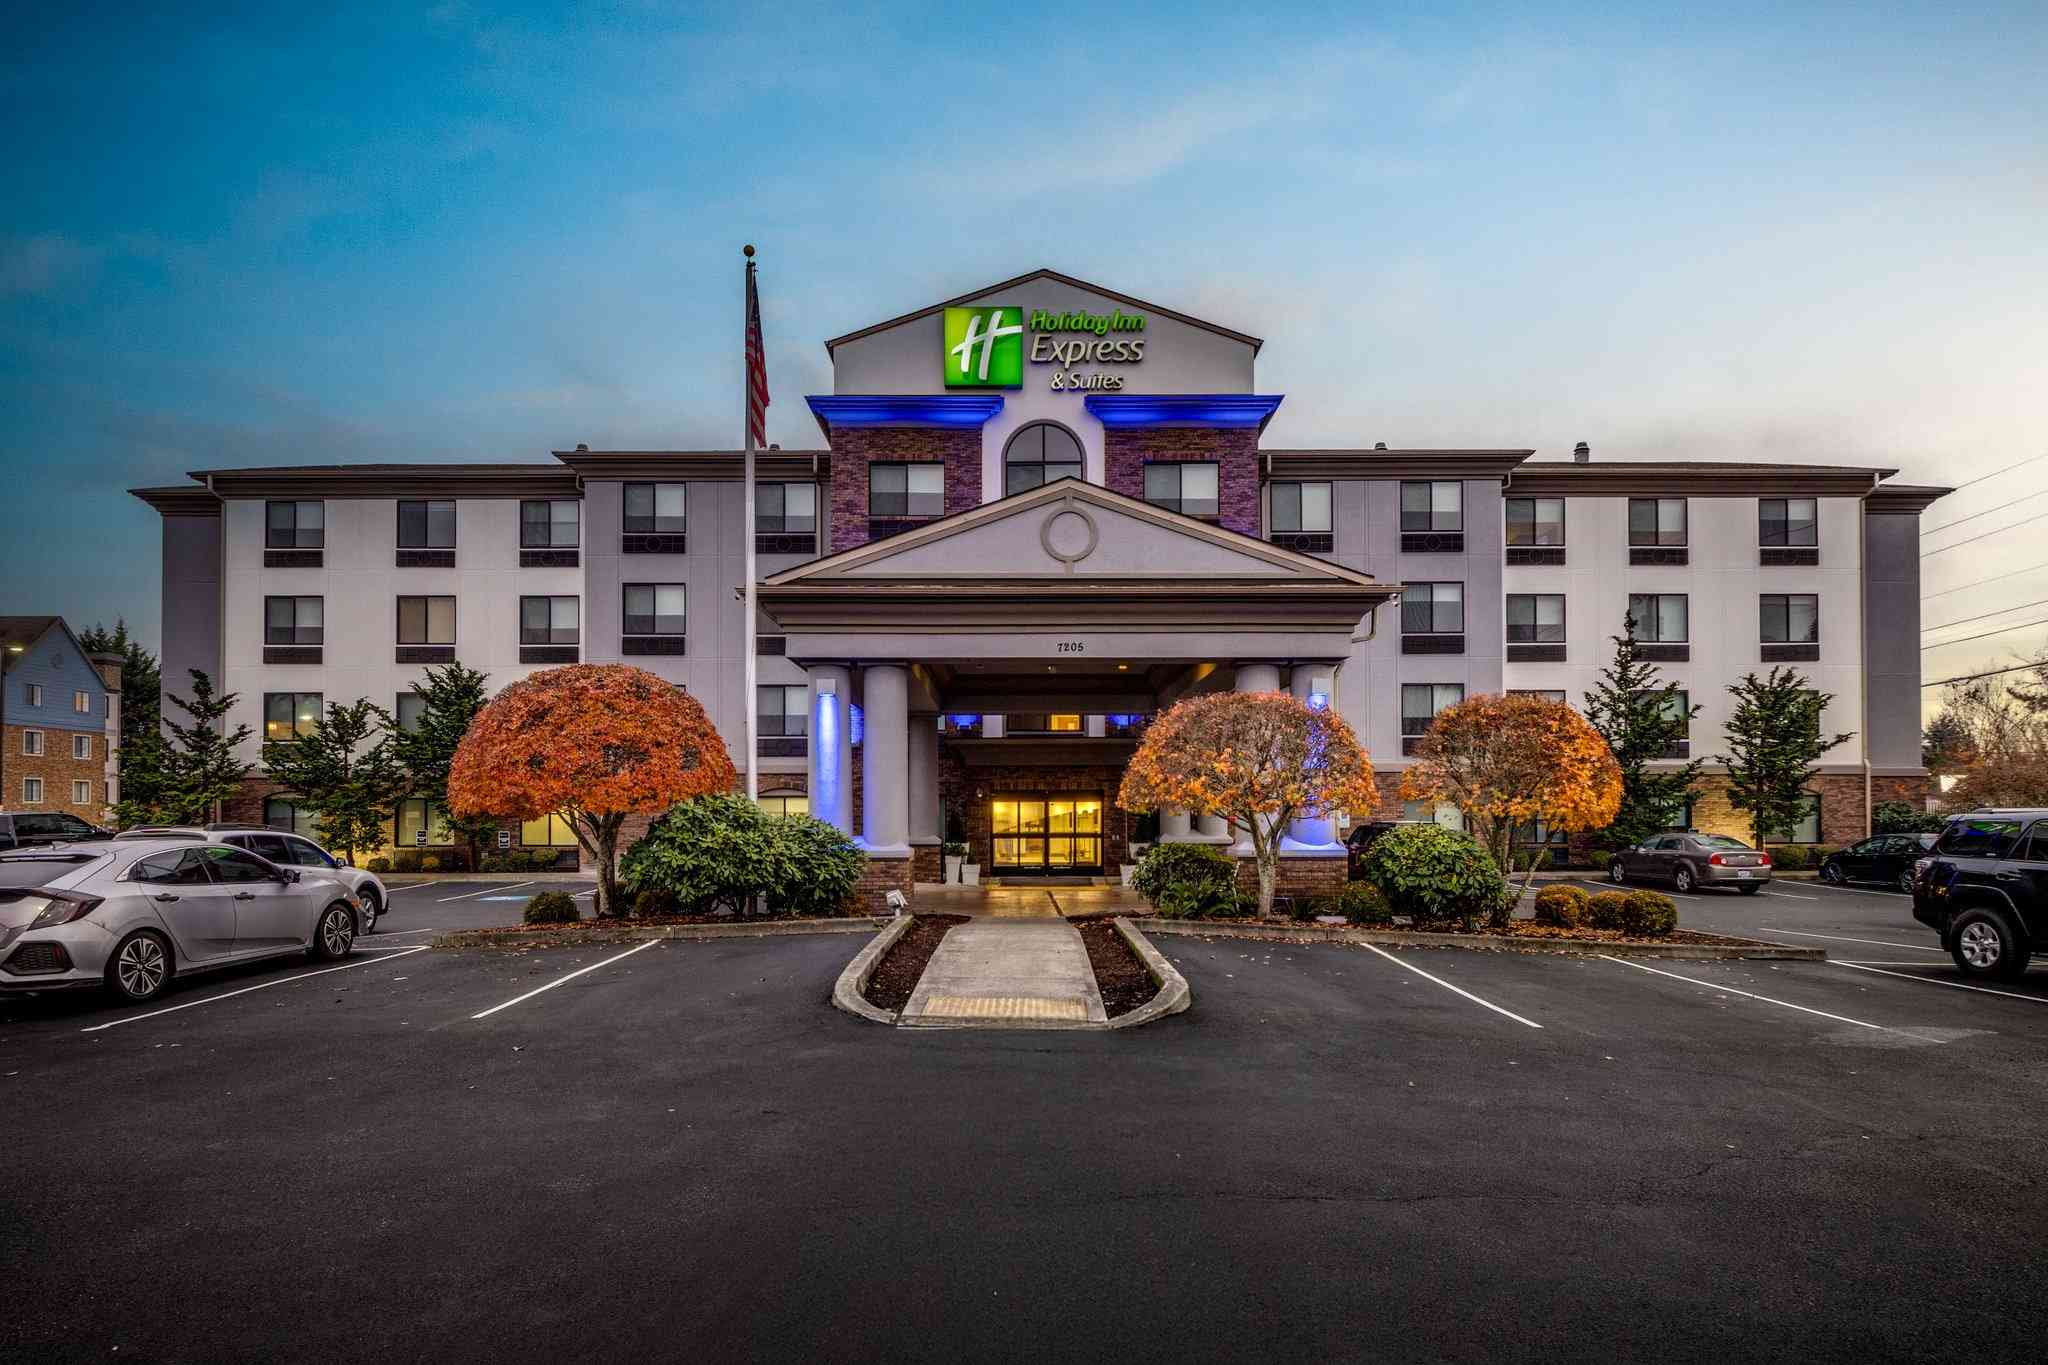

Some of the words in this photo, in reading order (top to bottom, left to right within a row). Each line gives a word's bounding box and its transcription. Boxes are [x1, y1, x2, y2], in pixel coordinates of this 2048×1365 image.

[1030, 310, 1109, 335] Holiday
[1112, 309, 1145, 331] Inn
[951, 310, 1023, 380] H
[1030, 333, 1145, 369] Express
[1051, 372, 1064, 390] &
[1069, 372, 1123, 390] Suites
[1057, 642, 1084, 652] 7205
